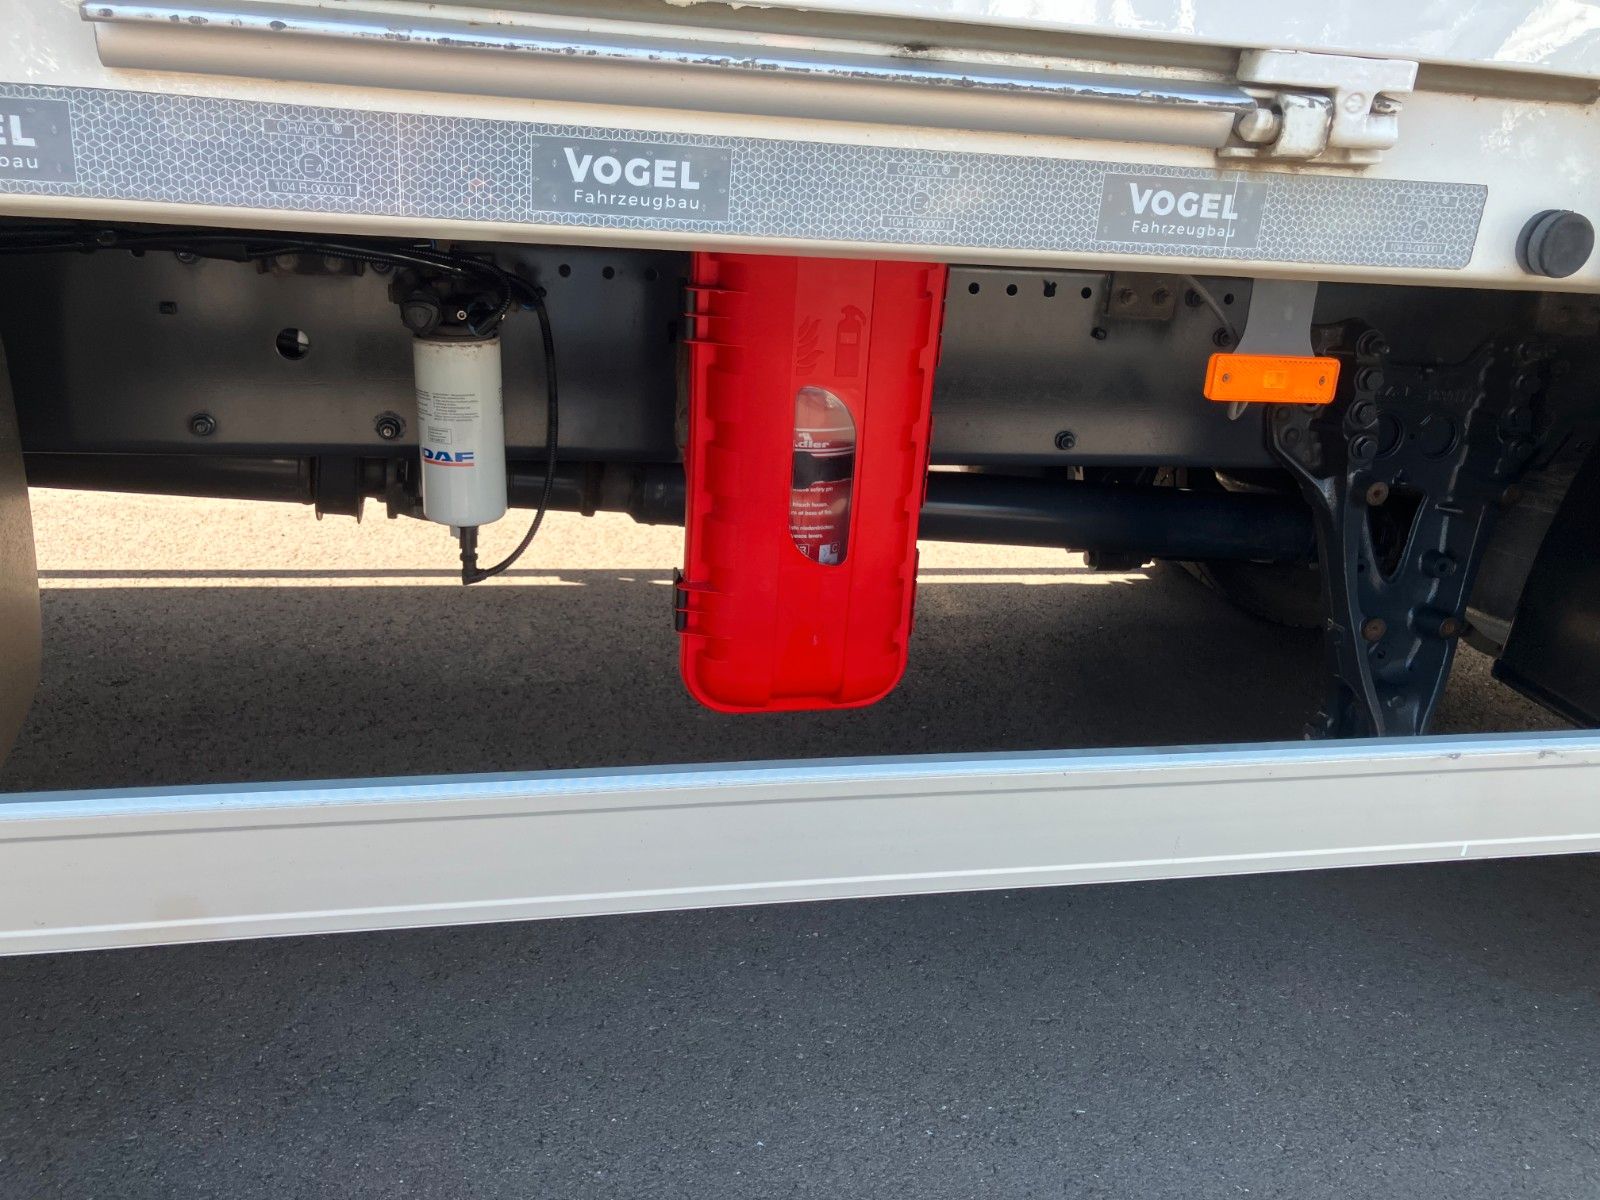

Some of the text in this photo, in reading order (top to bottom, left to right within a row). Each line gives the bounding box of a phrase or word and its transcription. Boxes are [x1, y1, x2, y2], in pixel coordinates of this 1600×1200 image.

[563, 147, 700, 190] VOGEL
[275, 181, 296, 193] 104
[573, 189, 700, 211] Fahrzeugbau
[1129, 183, 1238, 220] VOGEL
[1131, 220, 1236, 239] Fahrzeugbau
[421, 448, 474, 462] DAF
